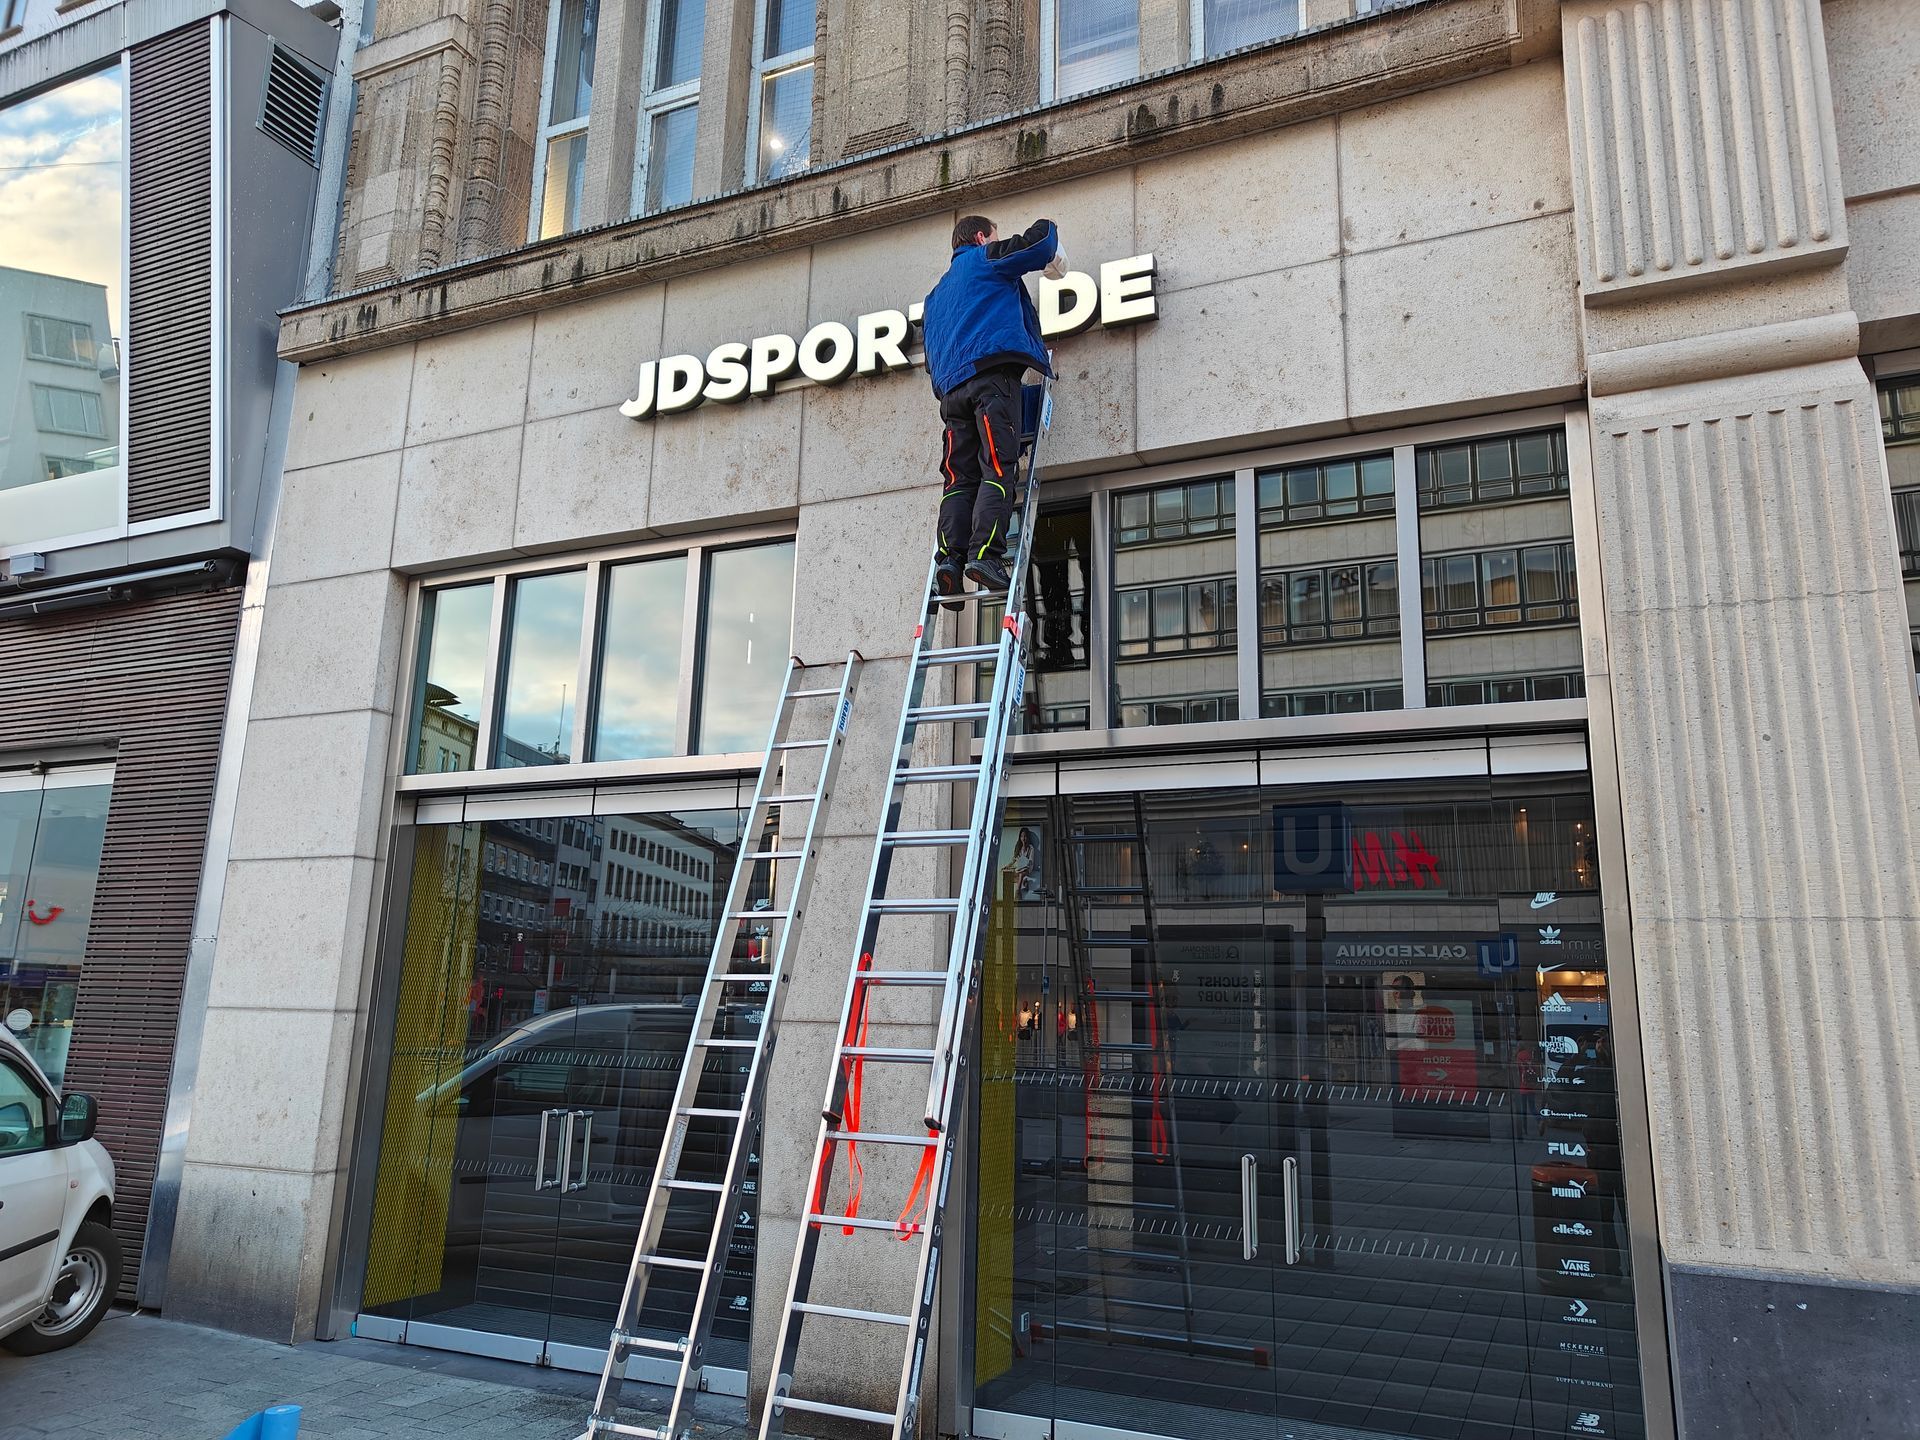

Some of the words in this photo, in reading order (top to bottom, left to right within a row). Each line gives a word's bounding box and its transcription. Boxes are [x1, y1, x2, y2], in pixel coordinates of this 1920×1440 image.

[619, 253, 1159, 421] JDSPORDE
[1016, 667, 1026, 705] KRAUSE
[837, 699, 851, 732] KRAUSE
[1535, 892, 1557, 903] NIKE
[1540, 1004, 1572, 1013] adidas
[1537, 1076, 1570, 1084] LACOSTE
[1540, 1109, 1588, 1118] Champion
[1547, 1142, 1586, 1157] FILA
[1552, 1187, 1581, 1198] PUMA
[1552, 1224, 1593, 1236] ellesse
[1561, 1259, 1591, 1272] VANS
[1563, 1315, 1597, 1324] CONVERSE
[1560, 1342, 1605, 1352] MCKENZIE
[1556, 1376, 1578, 1385] SUPPLY
[1586, 1380, 1614, 1389] DEMAND
[1582, 1425, 1605, 1434] balance
